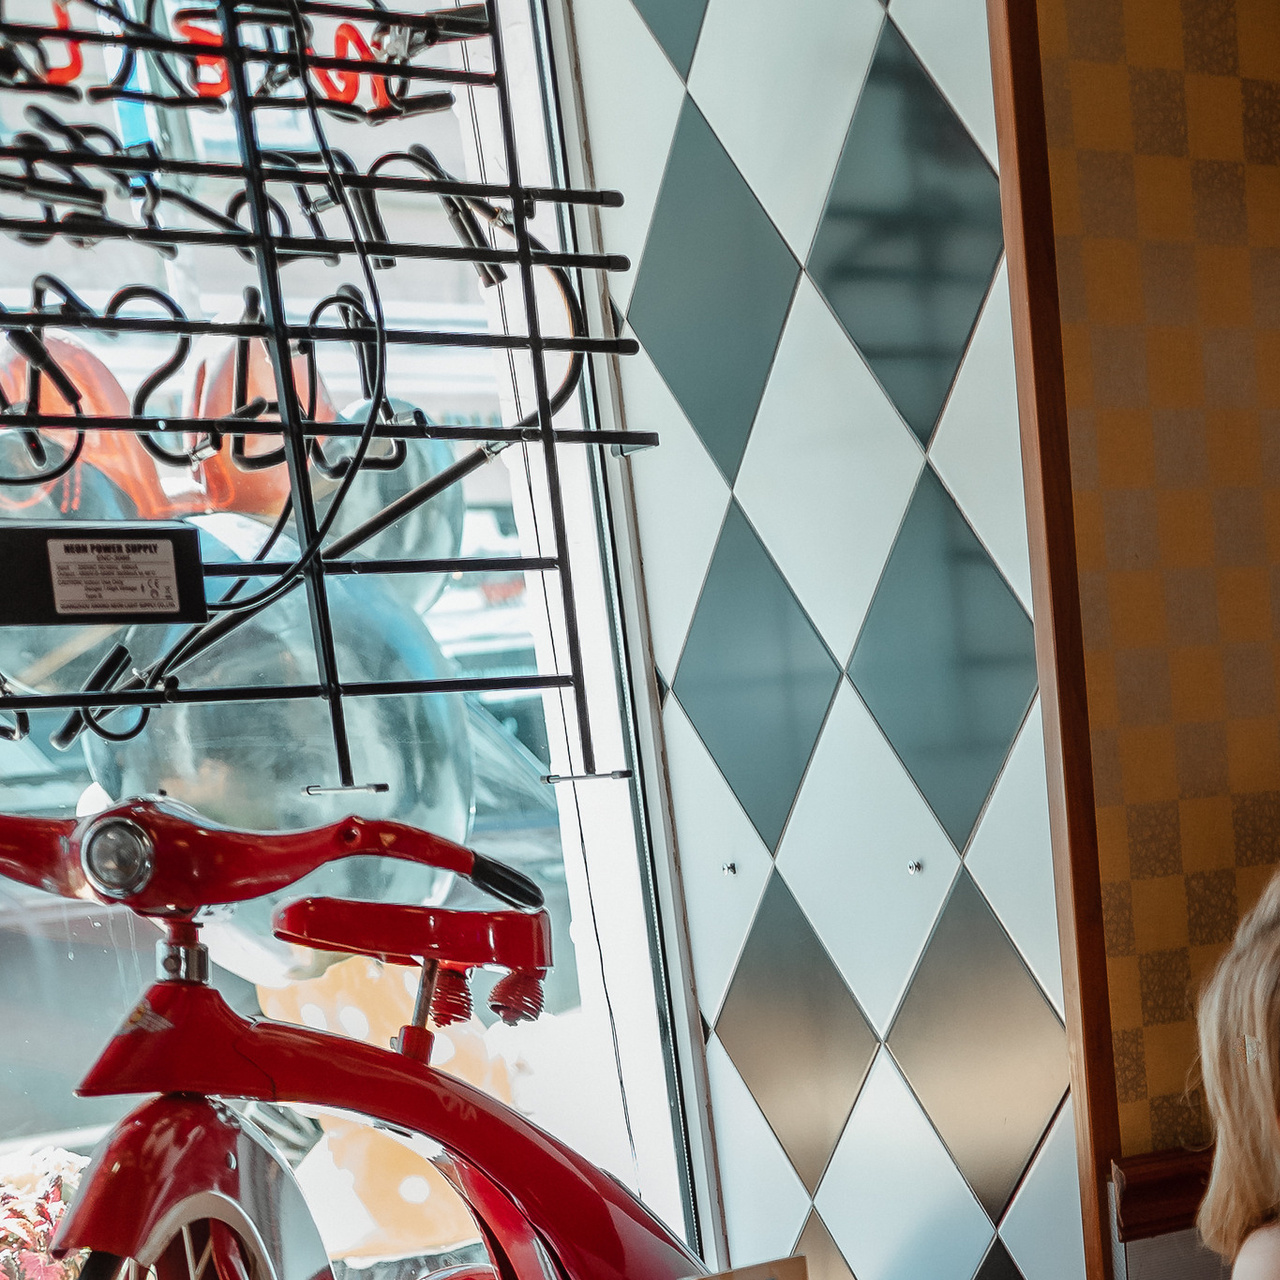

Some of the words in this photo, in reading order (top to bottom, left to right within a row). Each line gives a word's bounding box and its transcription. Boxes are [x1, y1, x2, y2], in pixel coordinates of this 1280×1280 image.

[63, 543, 88, 554] NEON
[90, 543, 123, 554] POWER
[125, 543, 158, 554] SUPPLY
